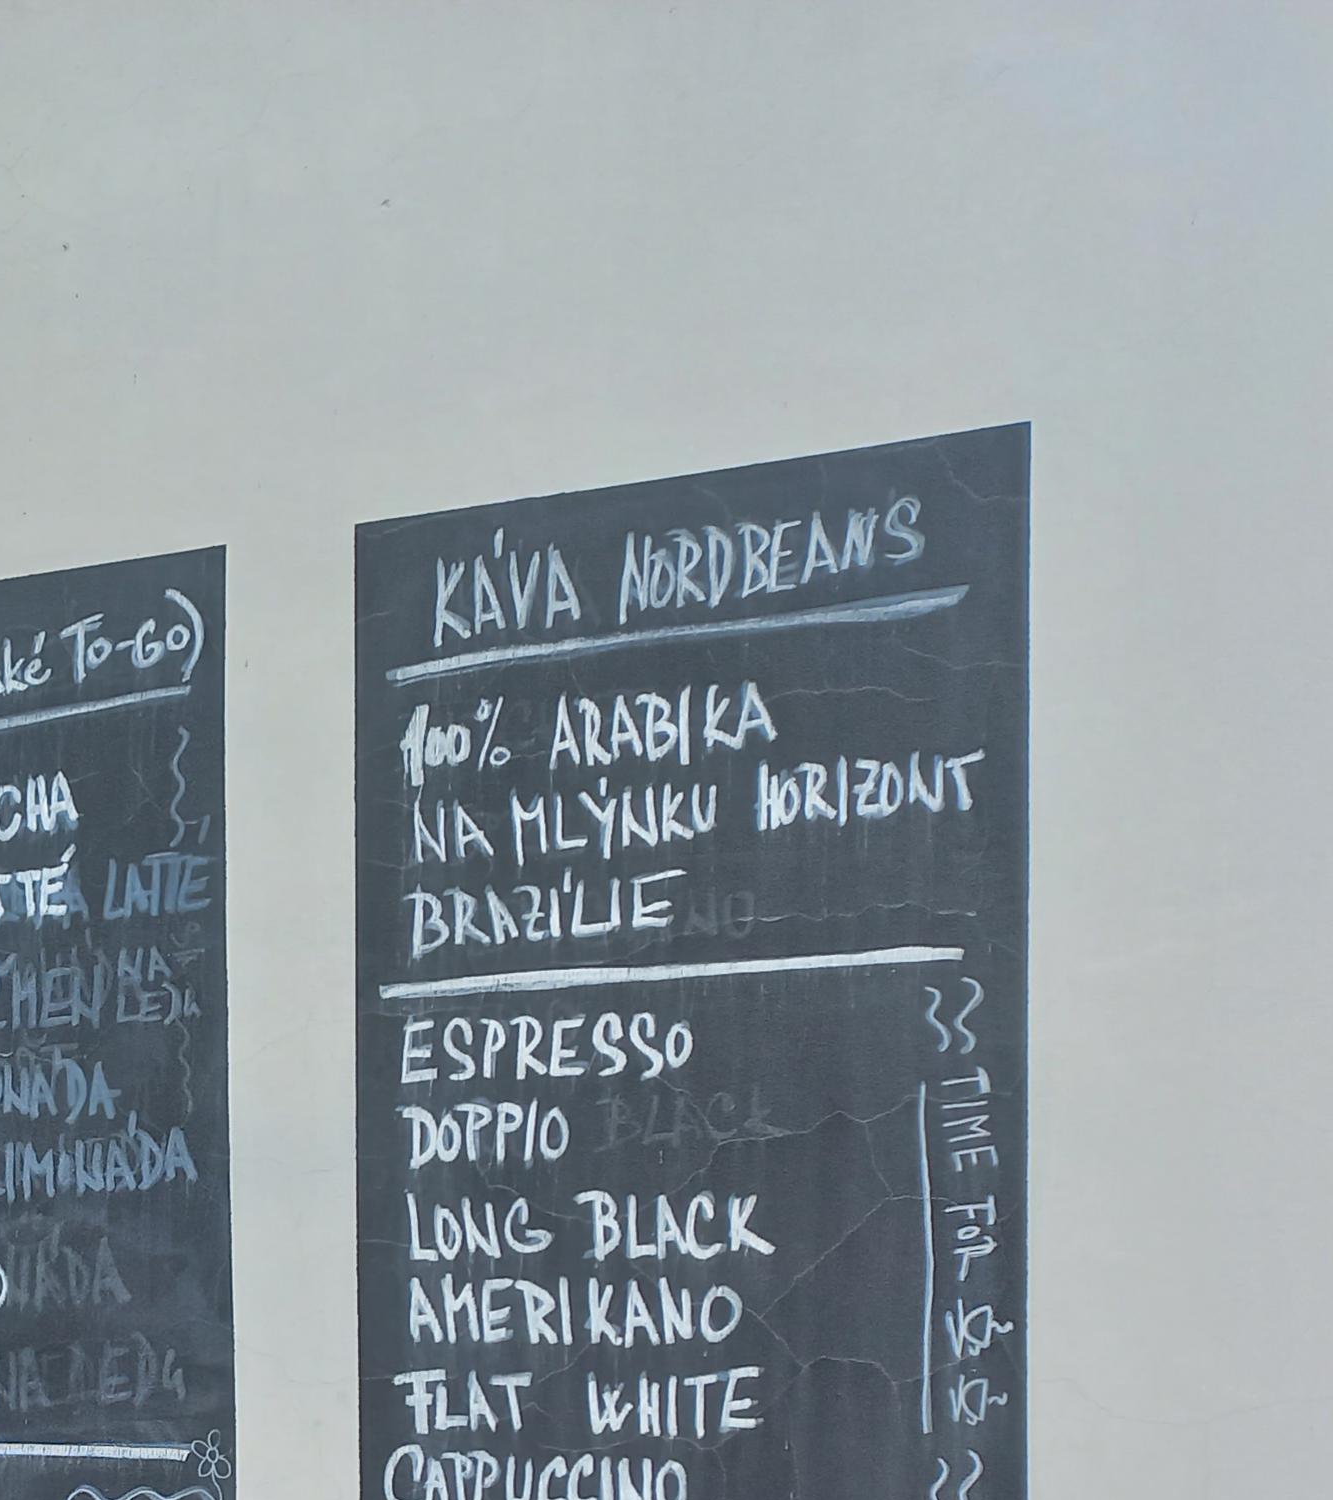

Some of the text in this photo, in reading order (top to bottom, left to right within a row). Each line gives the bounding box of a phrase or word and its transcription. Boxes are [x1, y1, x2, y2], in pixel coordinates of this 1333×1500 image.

[433, 527, 581, 648] KÁVA
[399, 680, 778, 787] 100% ARABIKA
[413, 749, 986, 867] NA MLÝNKU HORIZONT
[405, 868, 687, 966] BRAZÍLIE
[400, 1012, 694, 1084] ESPRESSO
[397, 1098, 569, 1169] DOPPIO
[941, 1066, 998, 1173] TIME
[406, 1189, 778, 1262] LONG BLACK
[408, 1273, 743, 1348] AMERIKANO
[393, 1365, 764, 1440] FLAT WHITE
